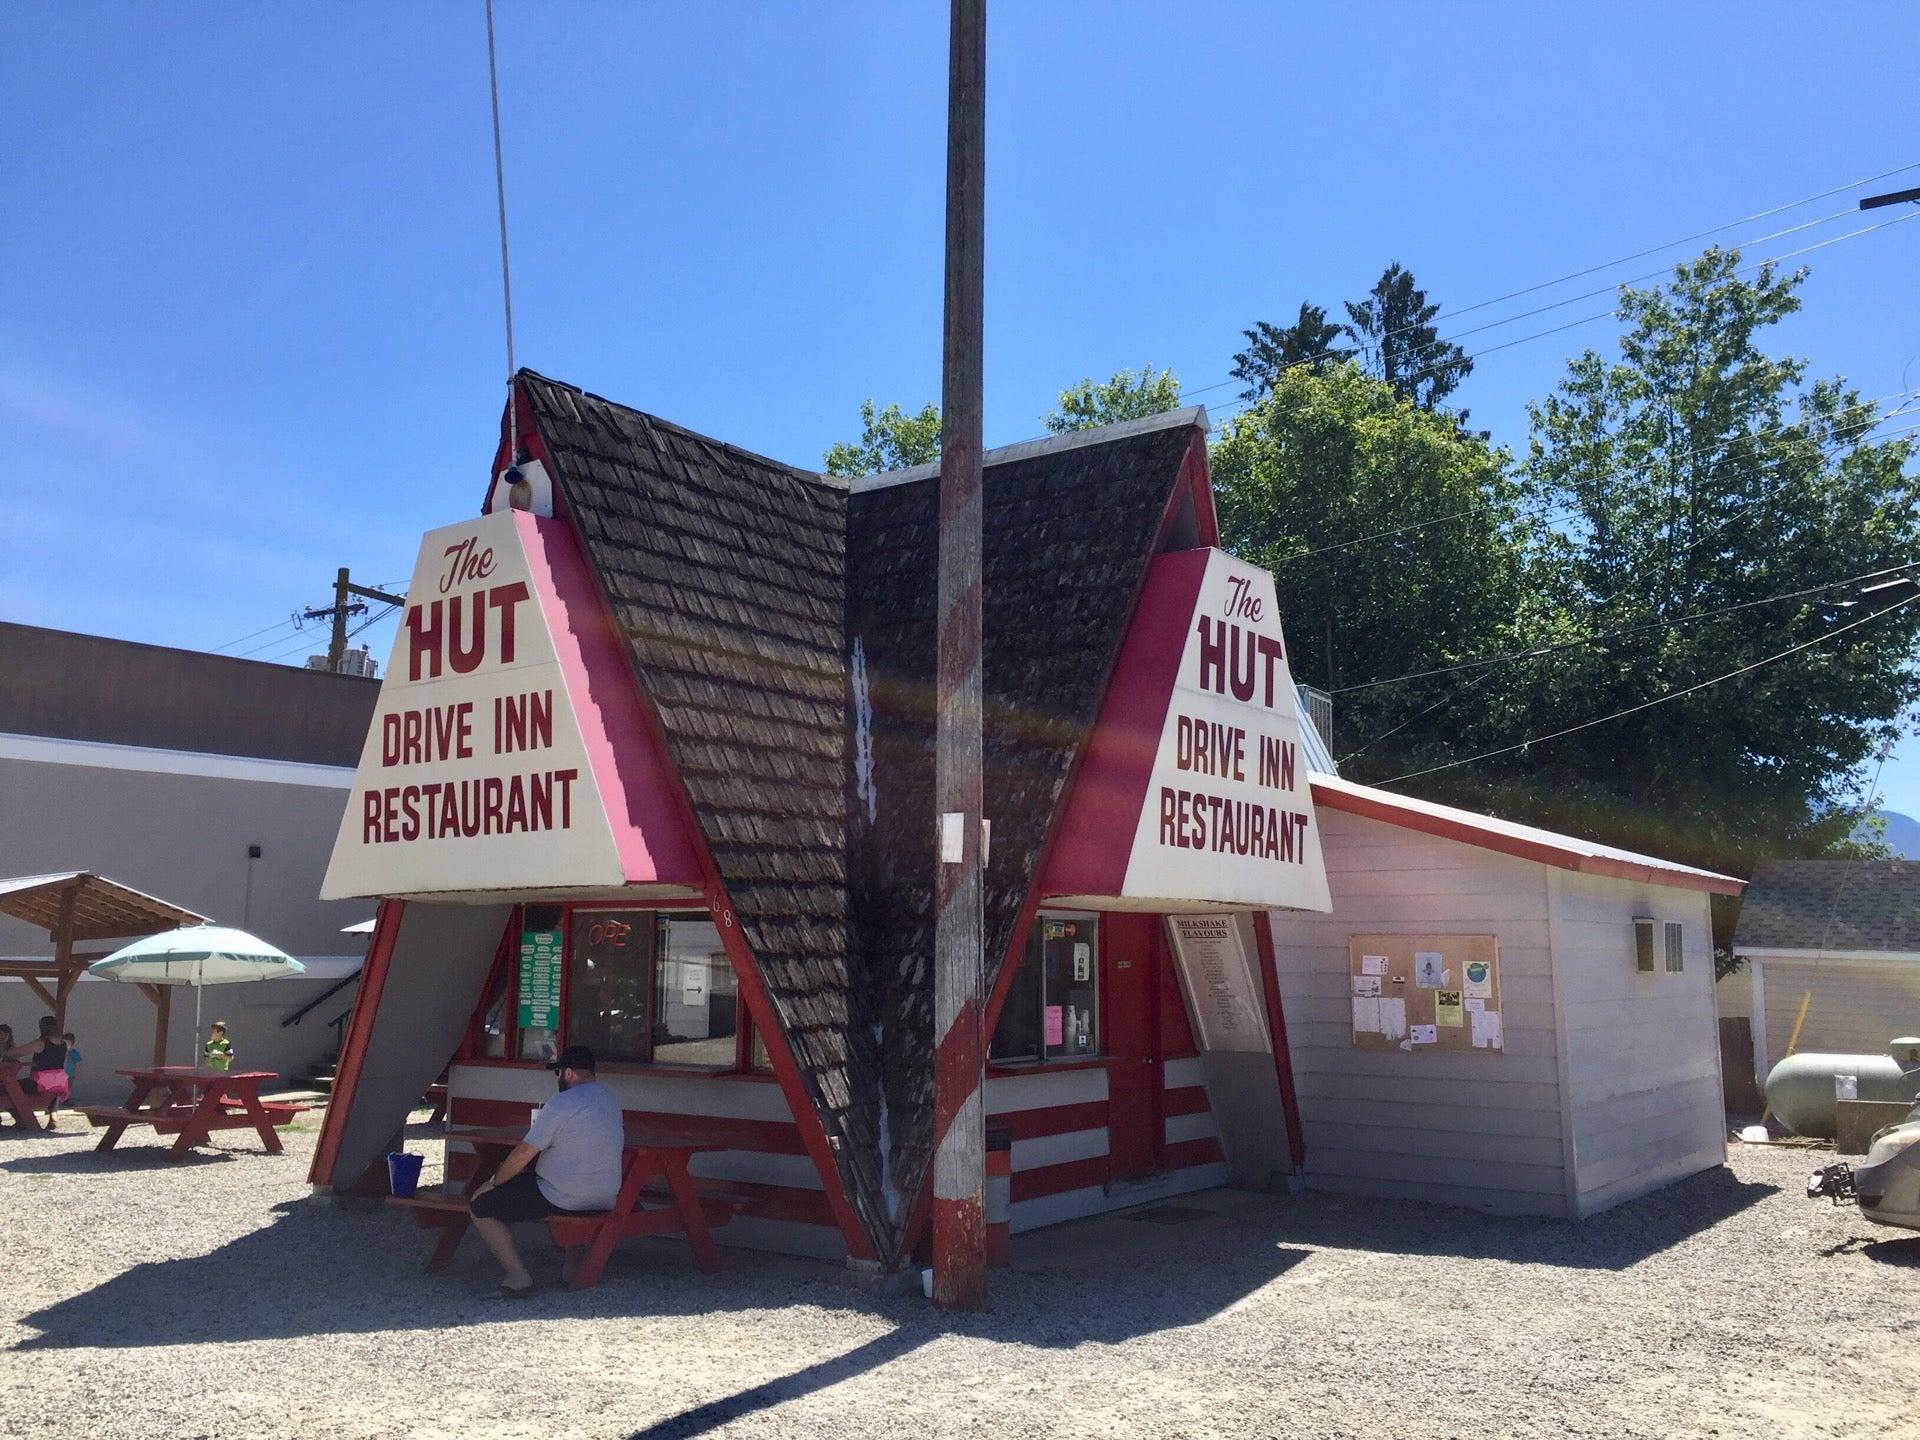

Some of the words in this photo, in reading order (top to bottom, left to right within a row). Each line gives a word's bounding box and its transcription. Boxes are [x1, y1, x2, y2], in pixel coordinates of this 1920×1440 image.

[439, 536, 499, 594] The
[1224, 575, 1265, 623] The
[405, 581, 530, 682] HUT
[1197, 614, 1283, 709] HUT
[382, 702, 473, 768] DRIVE
[494, 689, 553, 755] INN
[1177, 714, 1246, 782] DRIVE
[1259, 734, 1295, 792] INN
[363, 768, 578, 844] RESTAURANT
[1160, 786, 1308, 865] RESTAURANT
[1177, 919, 1227, 928] MILKSHAKE
